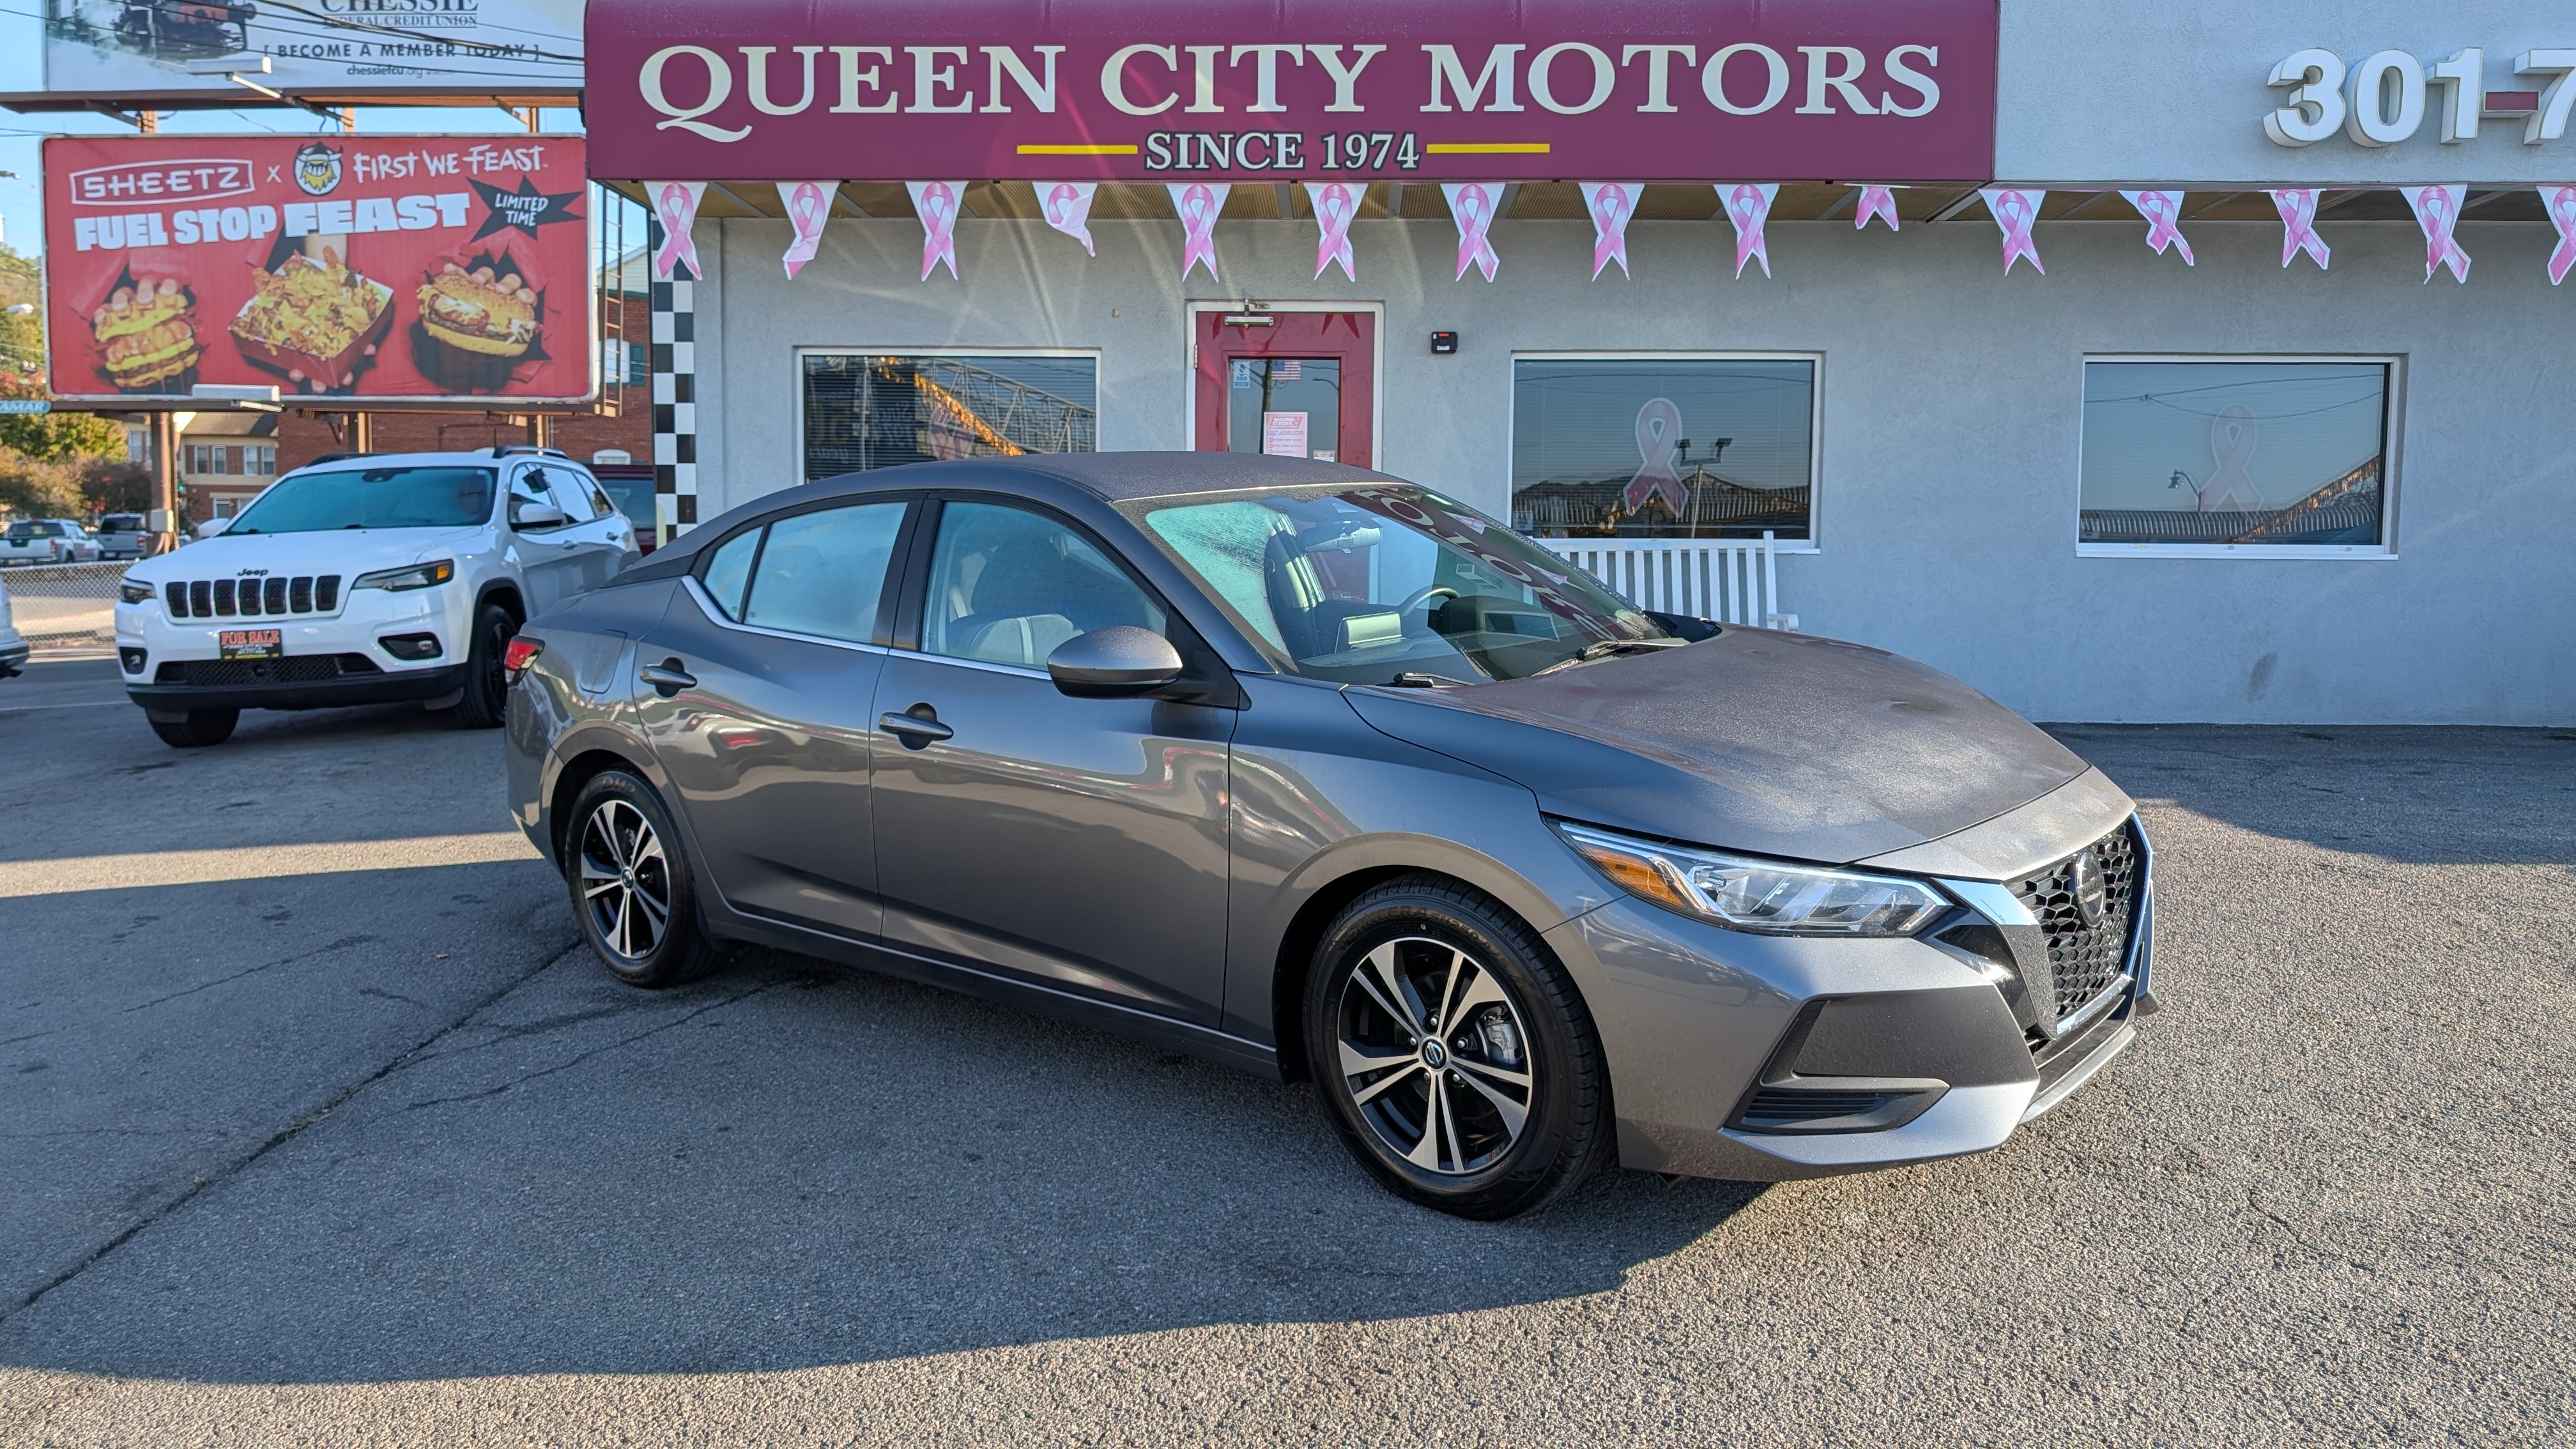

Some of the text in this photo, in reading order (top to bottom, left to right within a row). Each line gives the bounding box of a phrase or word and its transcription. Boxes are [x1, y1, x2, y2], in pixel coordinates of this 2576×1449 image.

[384, 16, 431, 26] CREDIT
[436, 16, 477, 26] UNION
[277, 44, 351, 57] BECOME
[360, 43, 372, 57] A
[380, 43, 455, 57] MEMBER
[638, 42, 1942, 143] QUEEN CITY MOTORS
[1145, 130, 1423, 171] SINCE 1974
[82, 165, 241, 199] SHEETZ
[353, 150, 419, 184] FIRST
[421, 149, 461, 178] WE
[73, 192, 471, 252] FUEL STOP FEAST
[494, 192, 549, 227] LIMITED TIME
[237, 568, 268, 576] Jeep
[221, 630, 280, 645] FOR SALE
